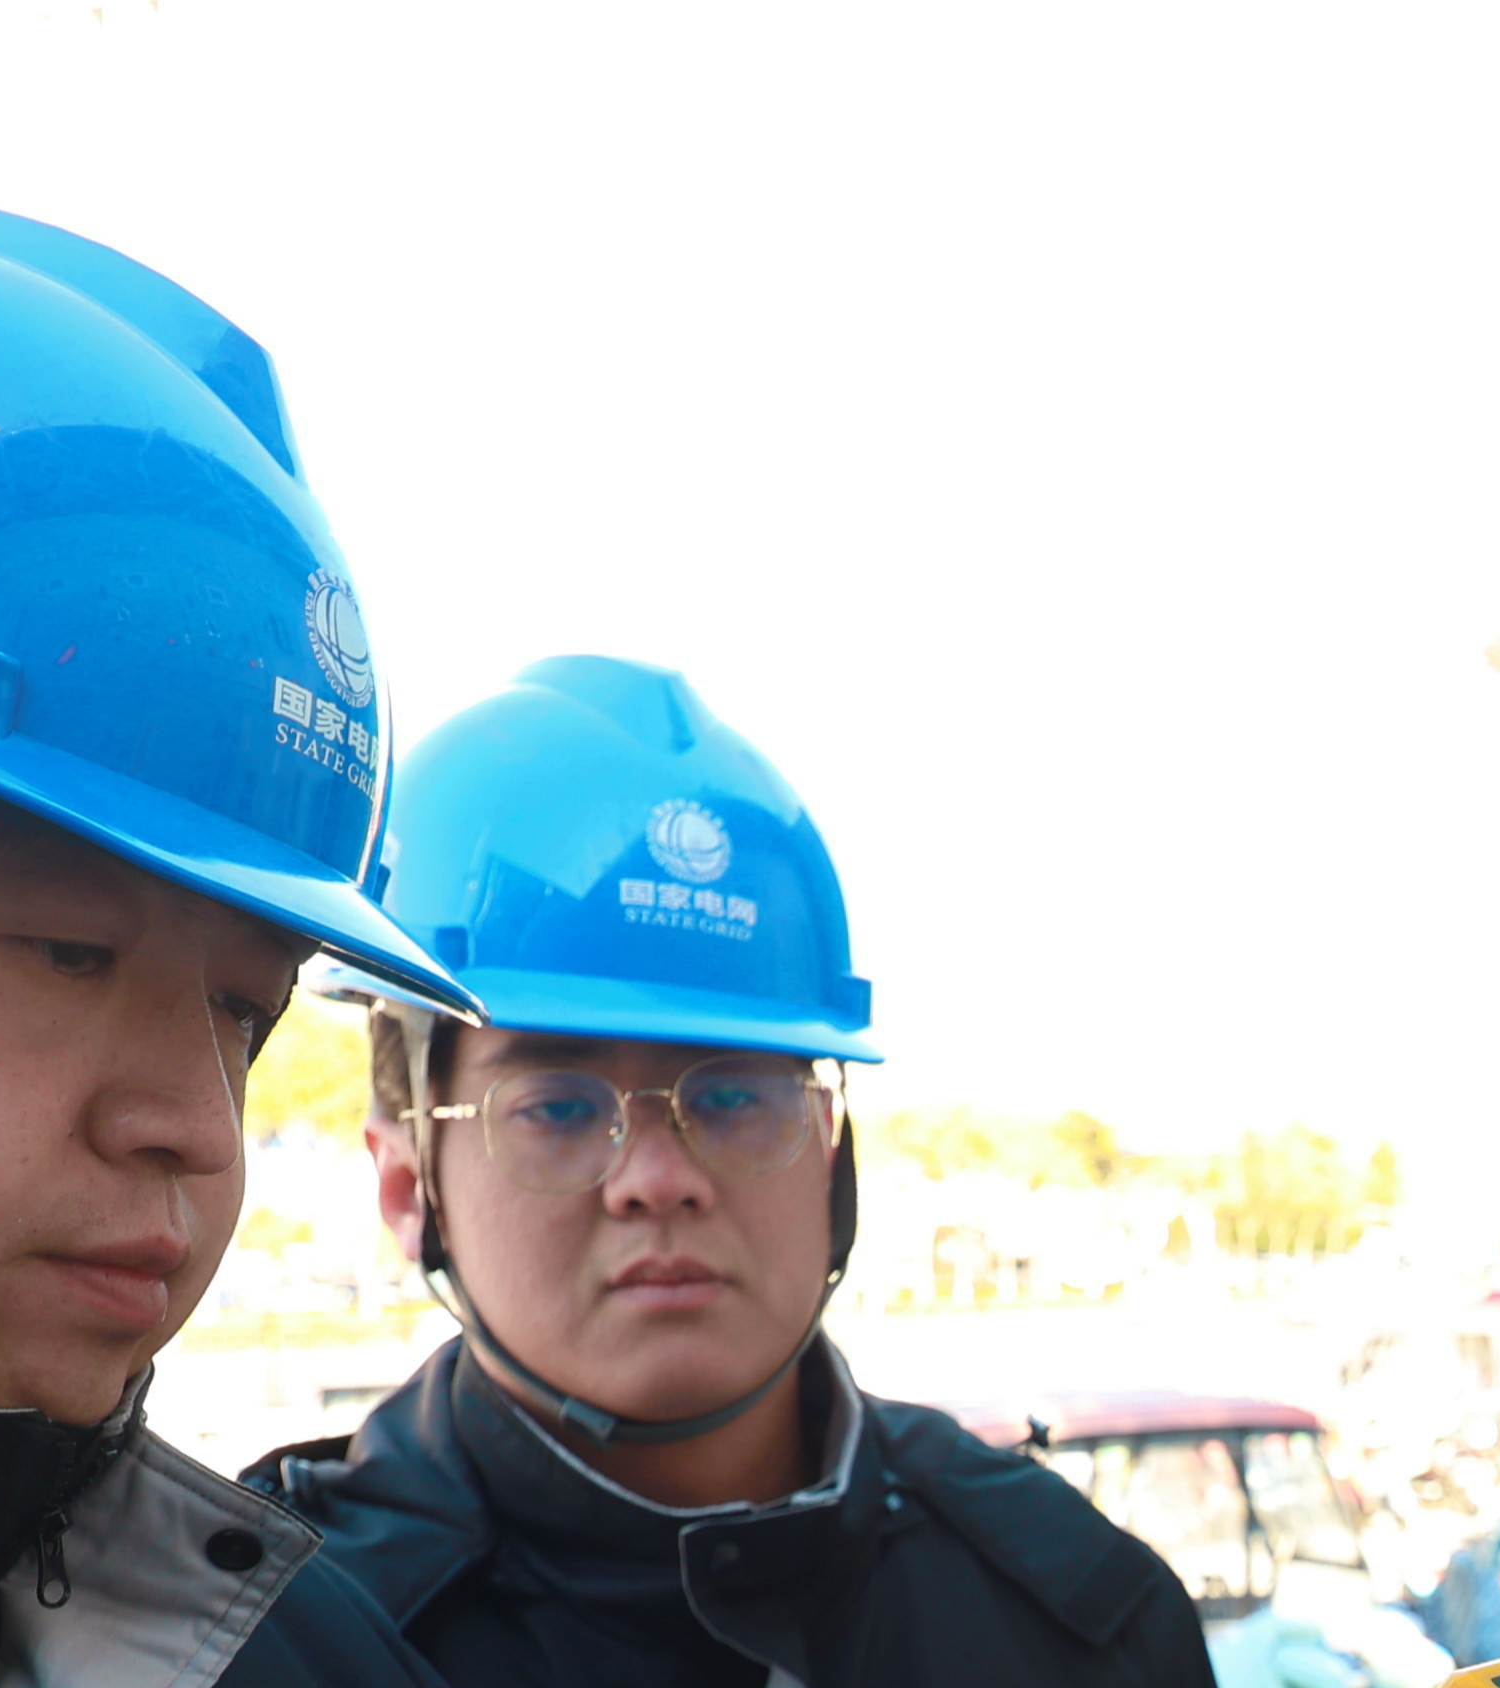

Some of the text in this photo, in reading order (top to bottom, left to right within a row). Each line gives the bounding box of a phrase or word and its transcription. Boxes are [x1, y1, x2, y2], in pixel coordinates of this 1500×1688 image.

[275, 722, 345, 775] STATE
[619, 878, 758, 926] 国家电网
[624, 907, 694, 930] STATE
